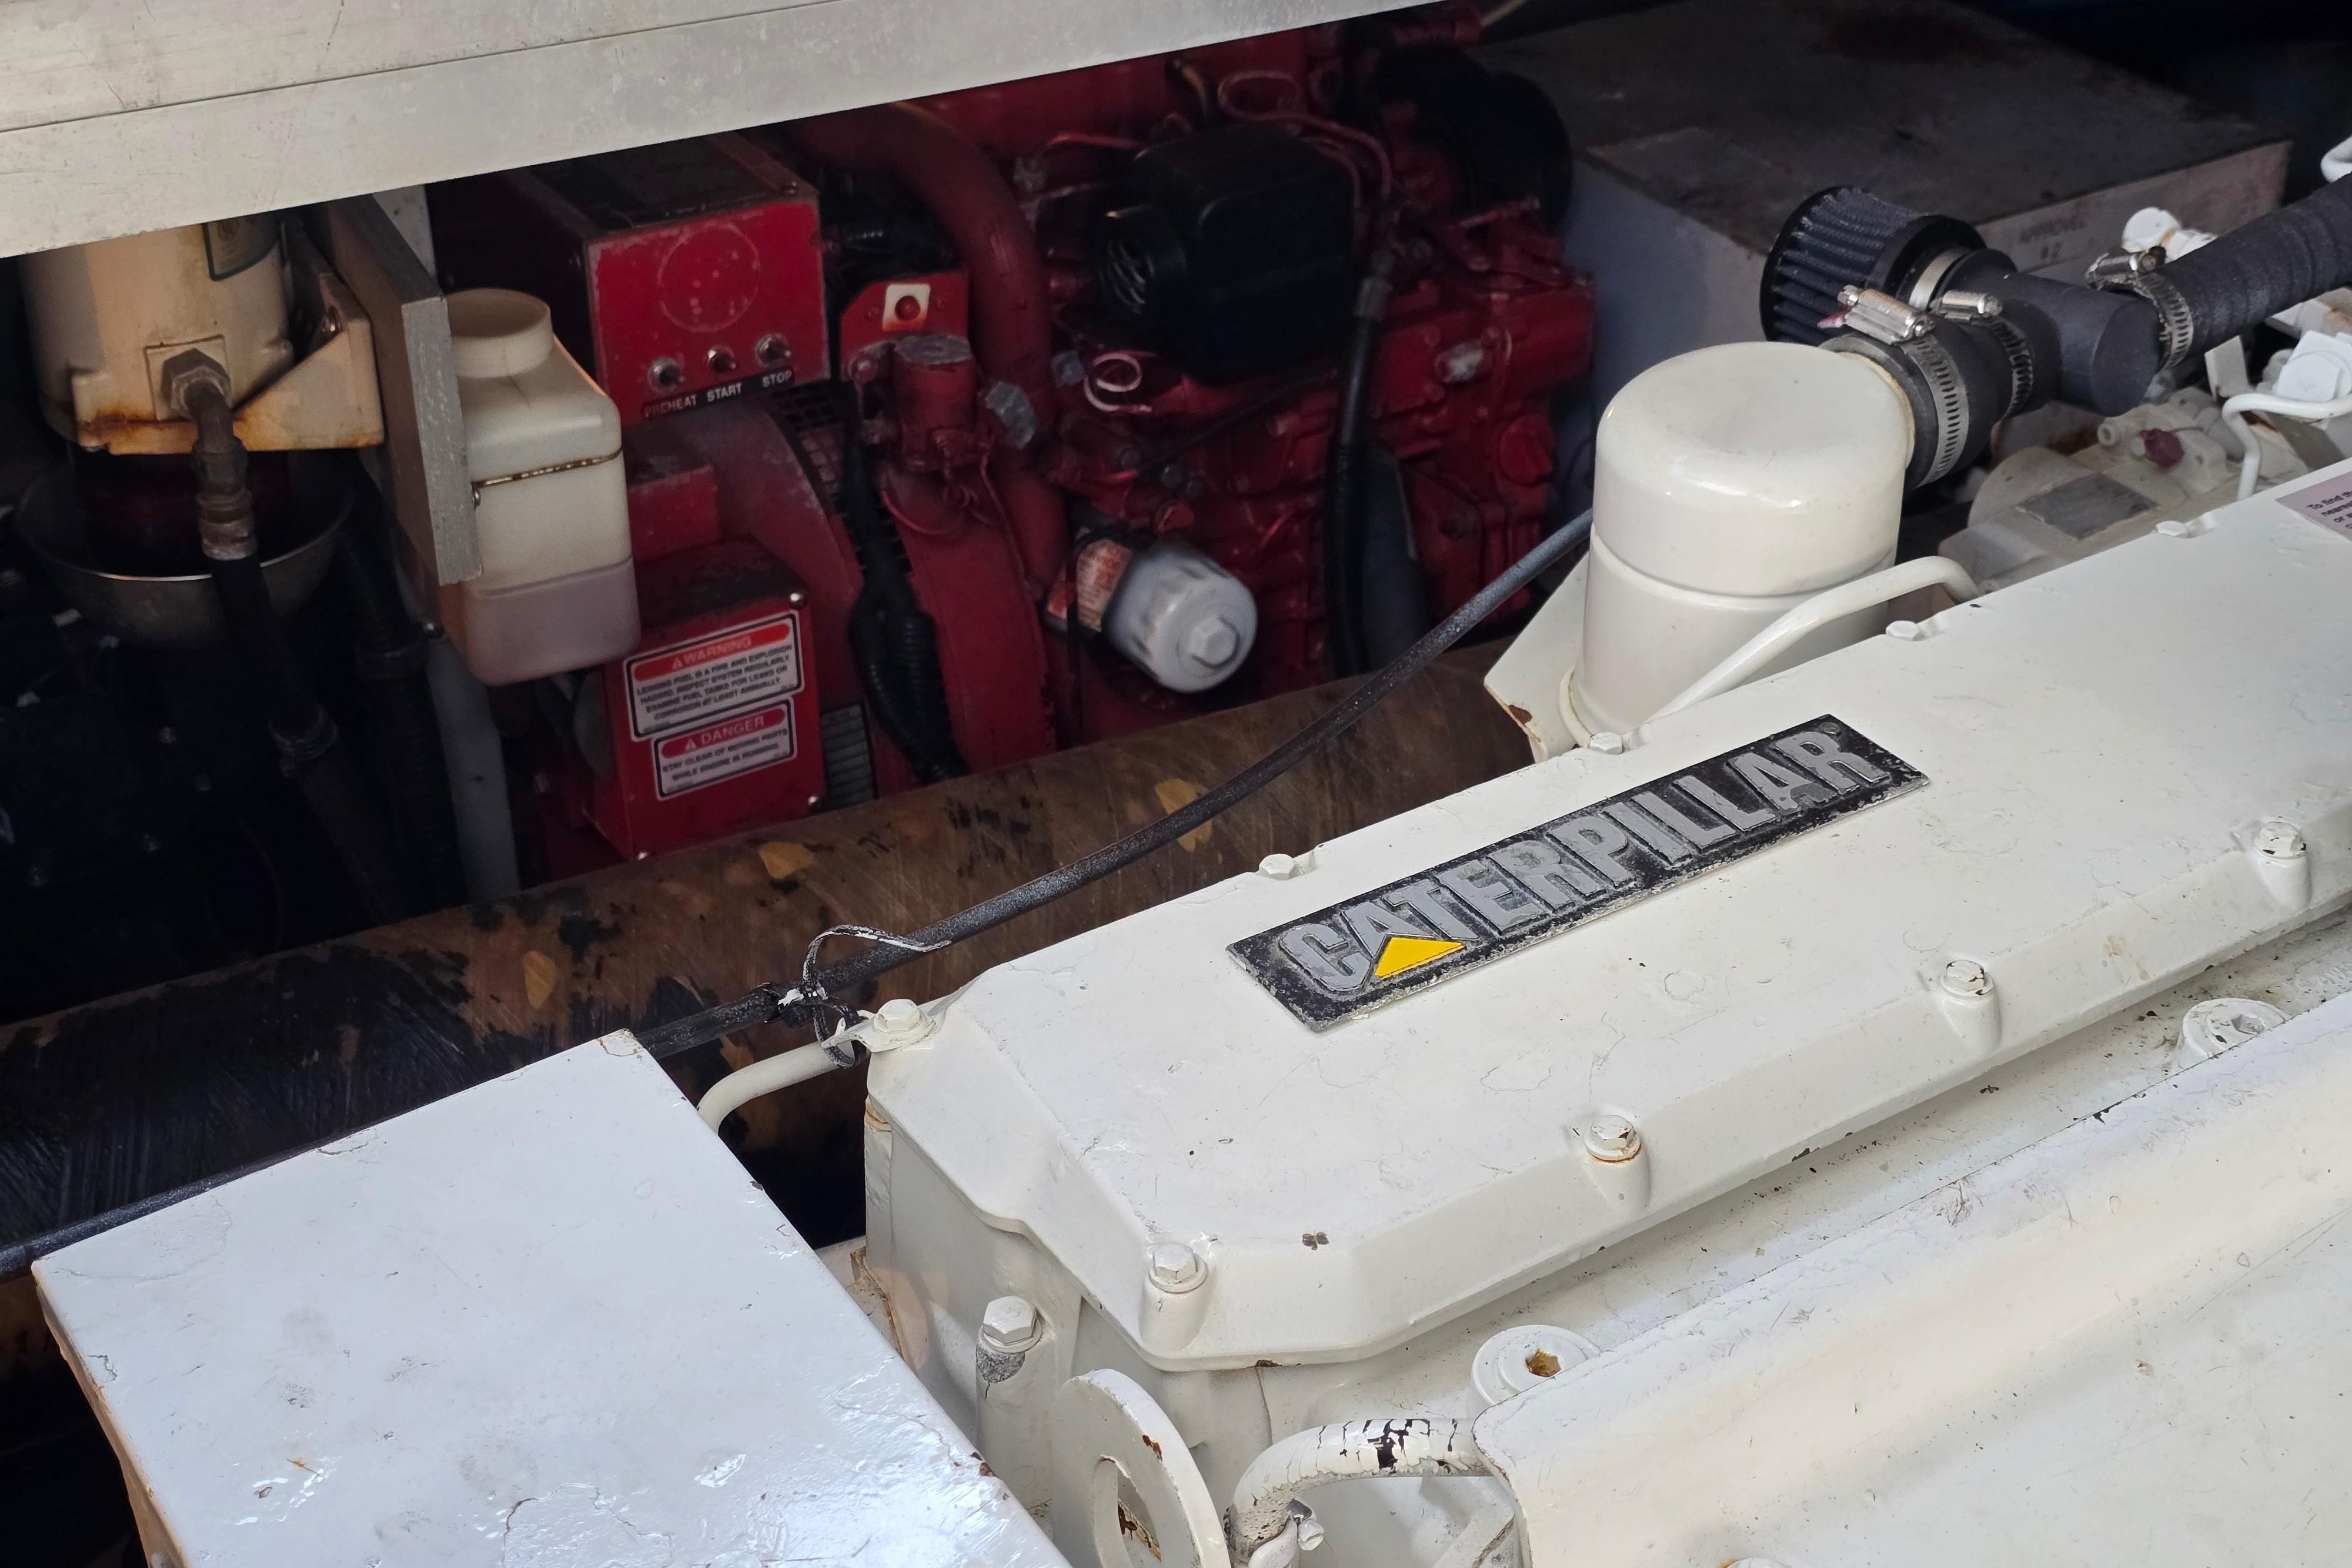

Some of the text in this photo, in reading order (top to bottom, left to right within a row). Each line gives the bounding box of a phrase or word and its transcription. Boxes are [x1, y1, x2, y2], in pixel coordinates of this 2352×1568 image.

[646, 371, 792, 417] PREHEAT START STOP
[700, 715, 764, 744] DANGER
[1277, 731, 1890, 992] CATERPILLAR
